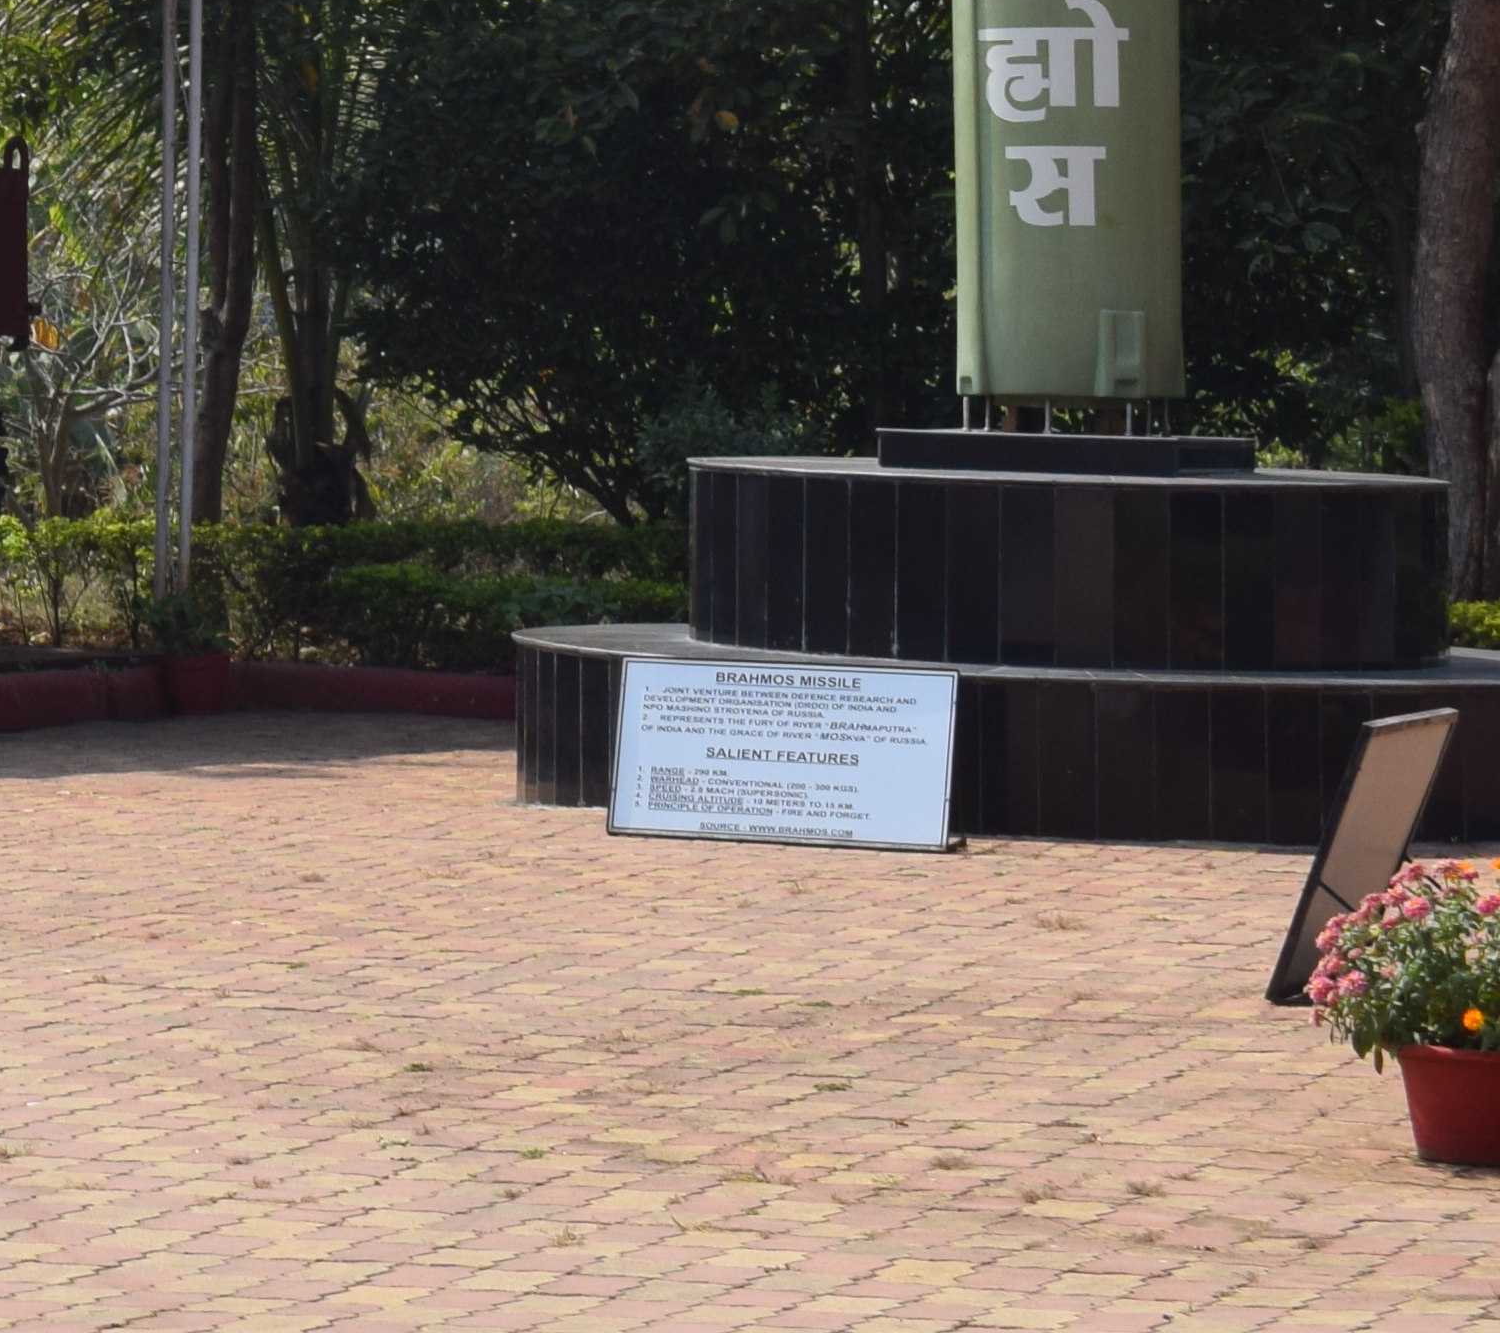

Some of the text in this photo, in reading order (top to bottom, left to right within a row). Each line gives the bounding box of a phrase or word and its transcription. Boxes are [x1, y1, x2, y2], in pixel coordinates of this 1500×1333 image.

[716, 672, 861, 689] BRAHMOS MISSILE
[643, 695, 715, 704] DEVELOPMENT
[848, 704, 874, 712] INDIA
[693, 688, 738, 696] VENTURE
[741, 690, 788, 699] BETWEEN
[791, 693, 836, 701] DEFENCE
[839, 695, 893, 704] RESEARCH
[660, 714, 724, 724] REPRESENTS
[793, 721, 821, 729] RIVER
[657, 725, 683, 733] INDIA
[729, 729, 764, 737] GRACE
[706, 747, 860, 765] SALIENT FEATURES
[651, 766, 685, 774] RANGE
[649, 784, 682, 792] SPEED
[706, 787, 735, 795] MACH
[650, 775, 700, 784] WARHEAD
[707, 778, 784, 789] CONVENTIONAL
[698, 795, 743, 804] ALTITUDE
[766, 799, 806, 808] METERS
[809, 801, 822, 809] TO
[648, 802, 700, 811] PRINCIPLE
[717, 806, 773, 815] OPERATION
[782, 809, 803, 817] FIRE
[806, 810, 827, 818] AND
[700, 822, 740, 831] SOURCE
[749, 825, 853, 837] WWW.BRAHMOS.COM
